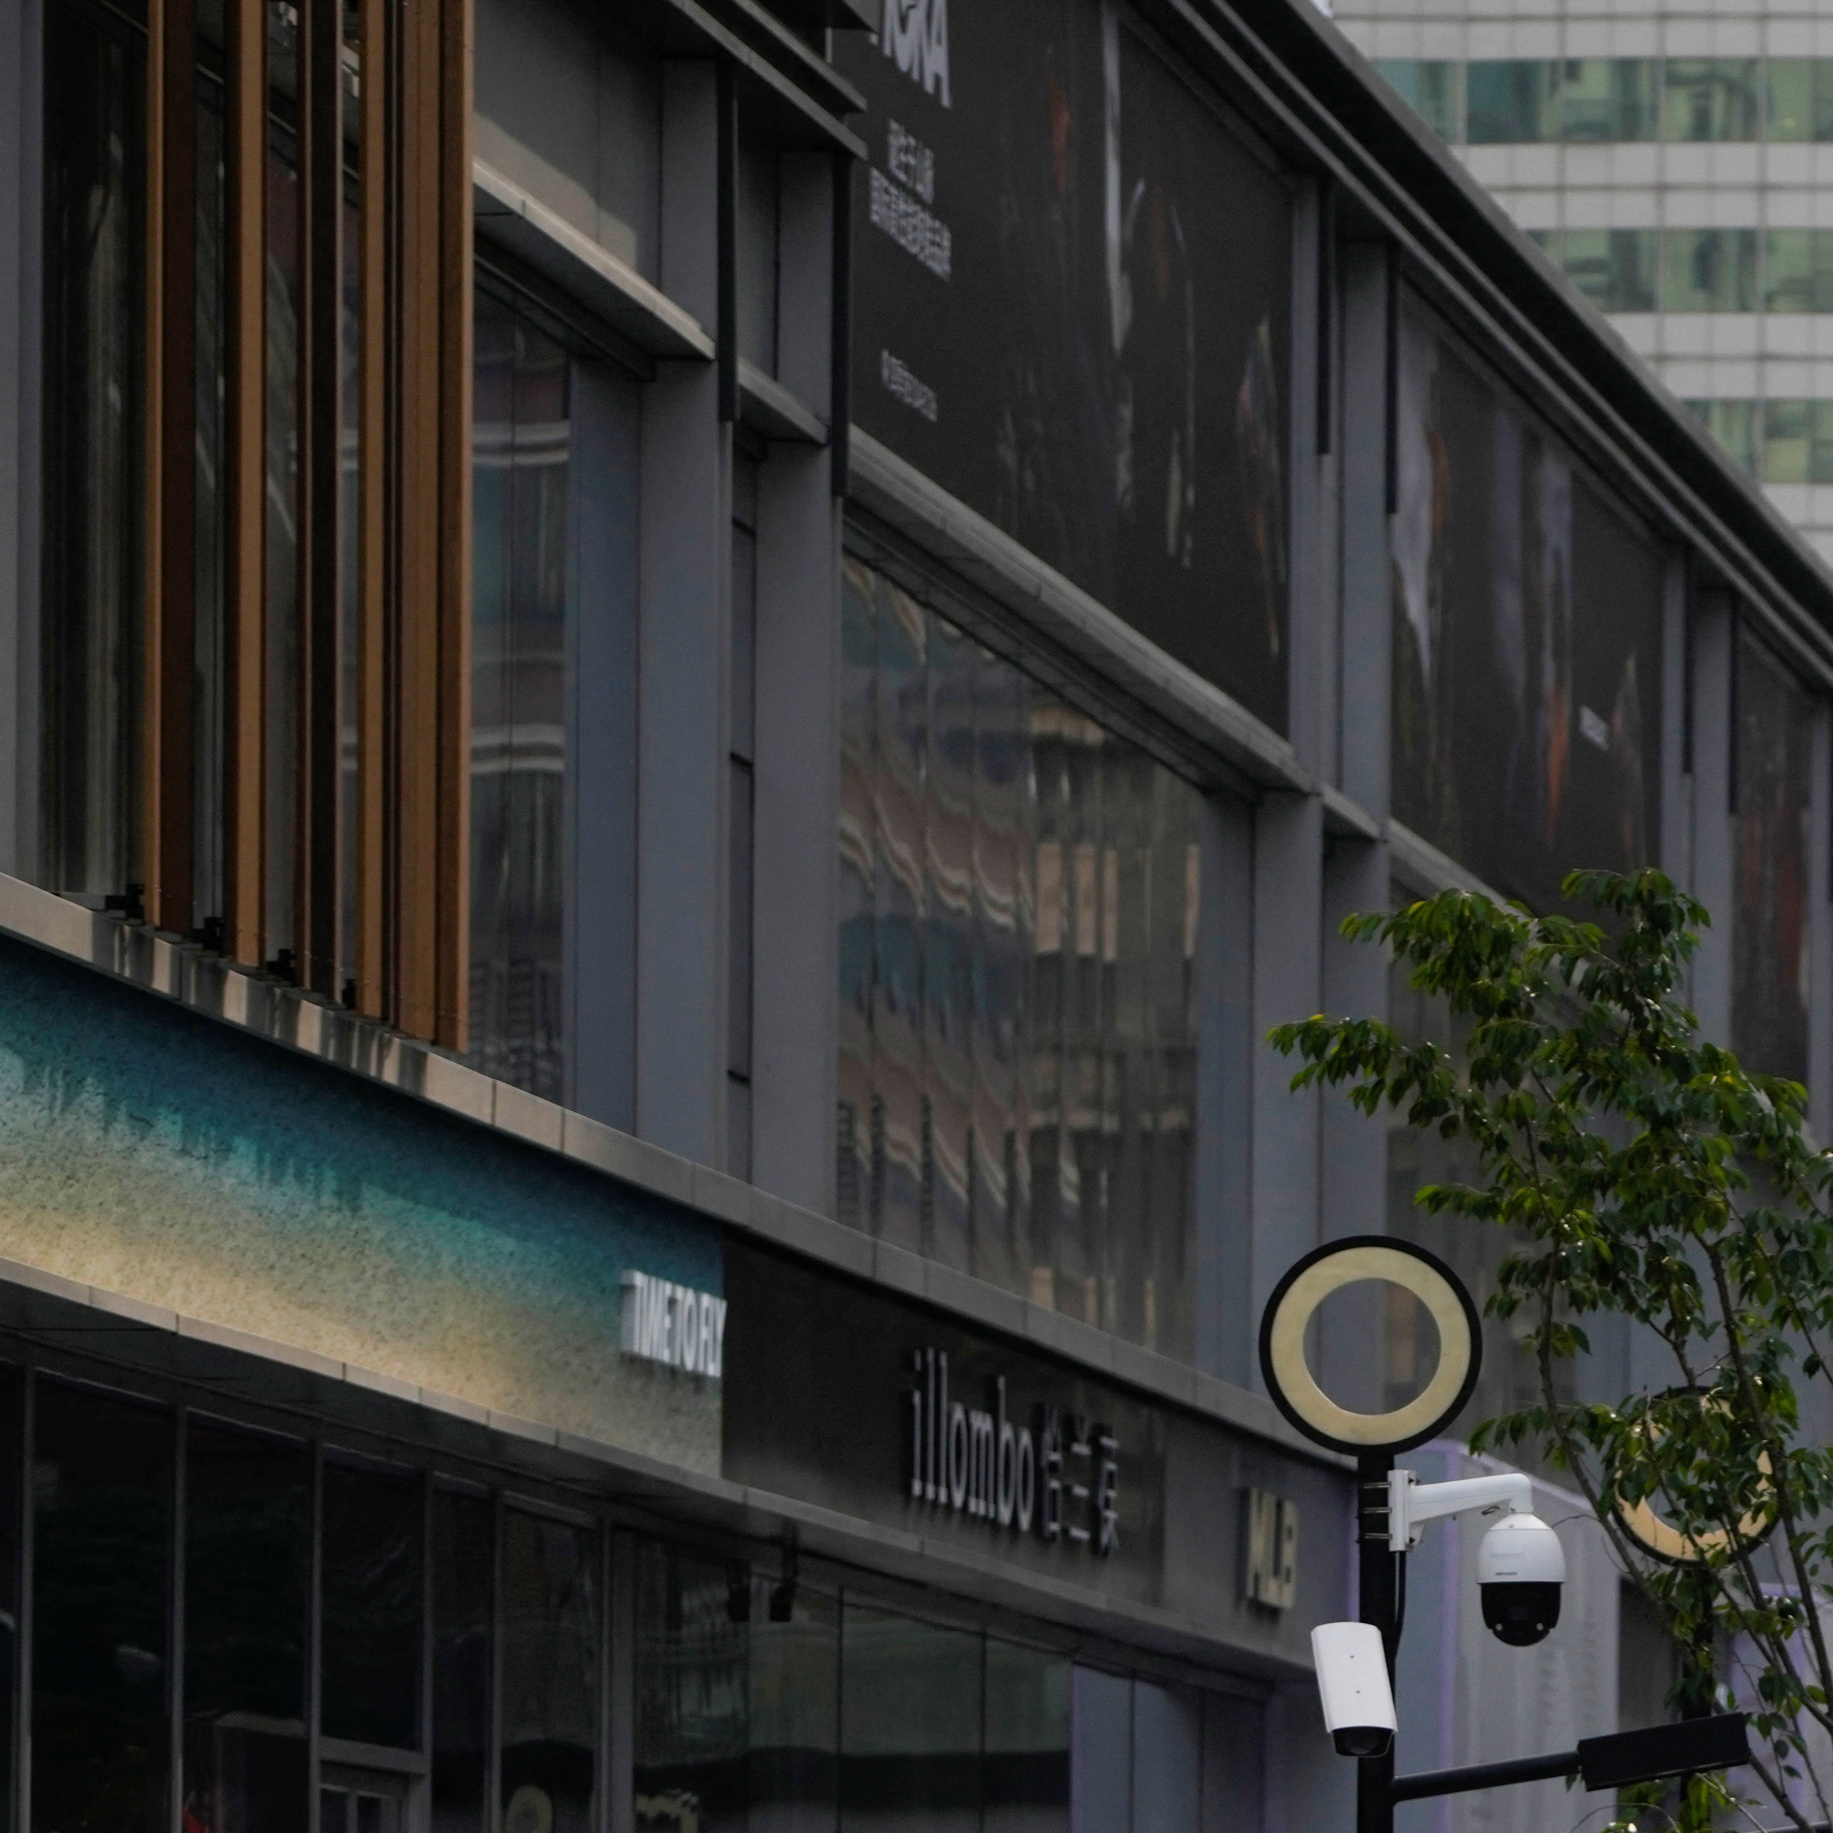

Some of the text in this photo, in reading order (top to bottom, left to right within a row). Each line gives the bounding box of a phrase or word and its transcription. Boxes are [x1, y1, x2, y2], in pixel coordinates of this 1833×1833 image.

[674, 1284, 698, 1371] TO
[698, 1291, 727, 1378] FLY
[910, 1347, 1035, 1532] illombo
